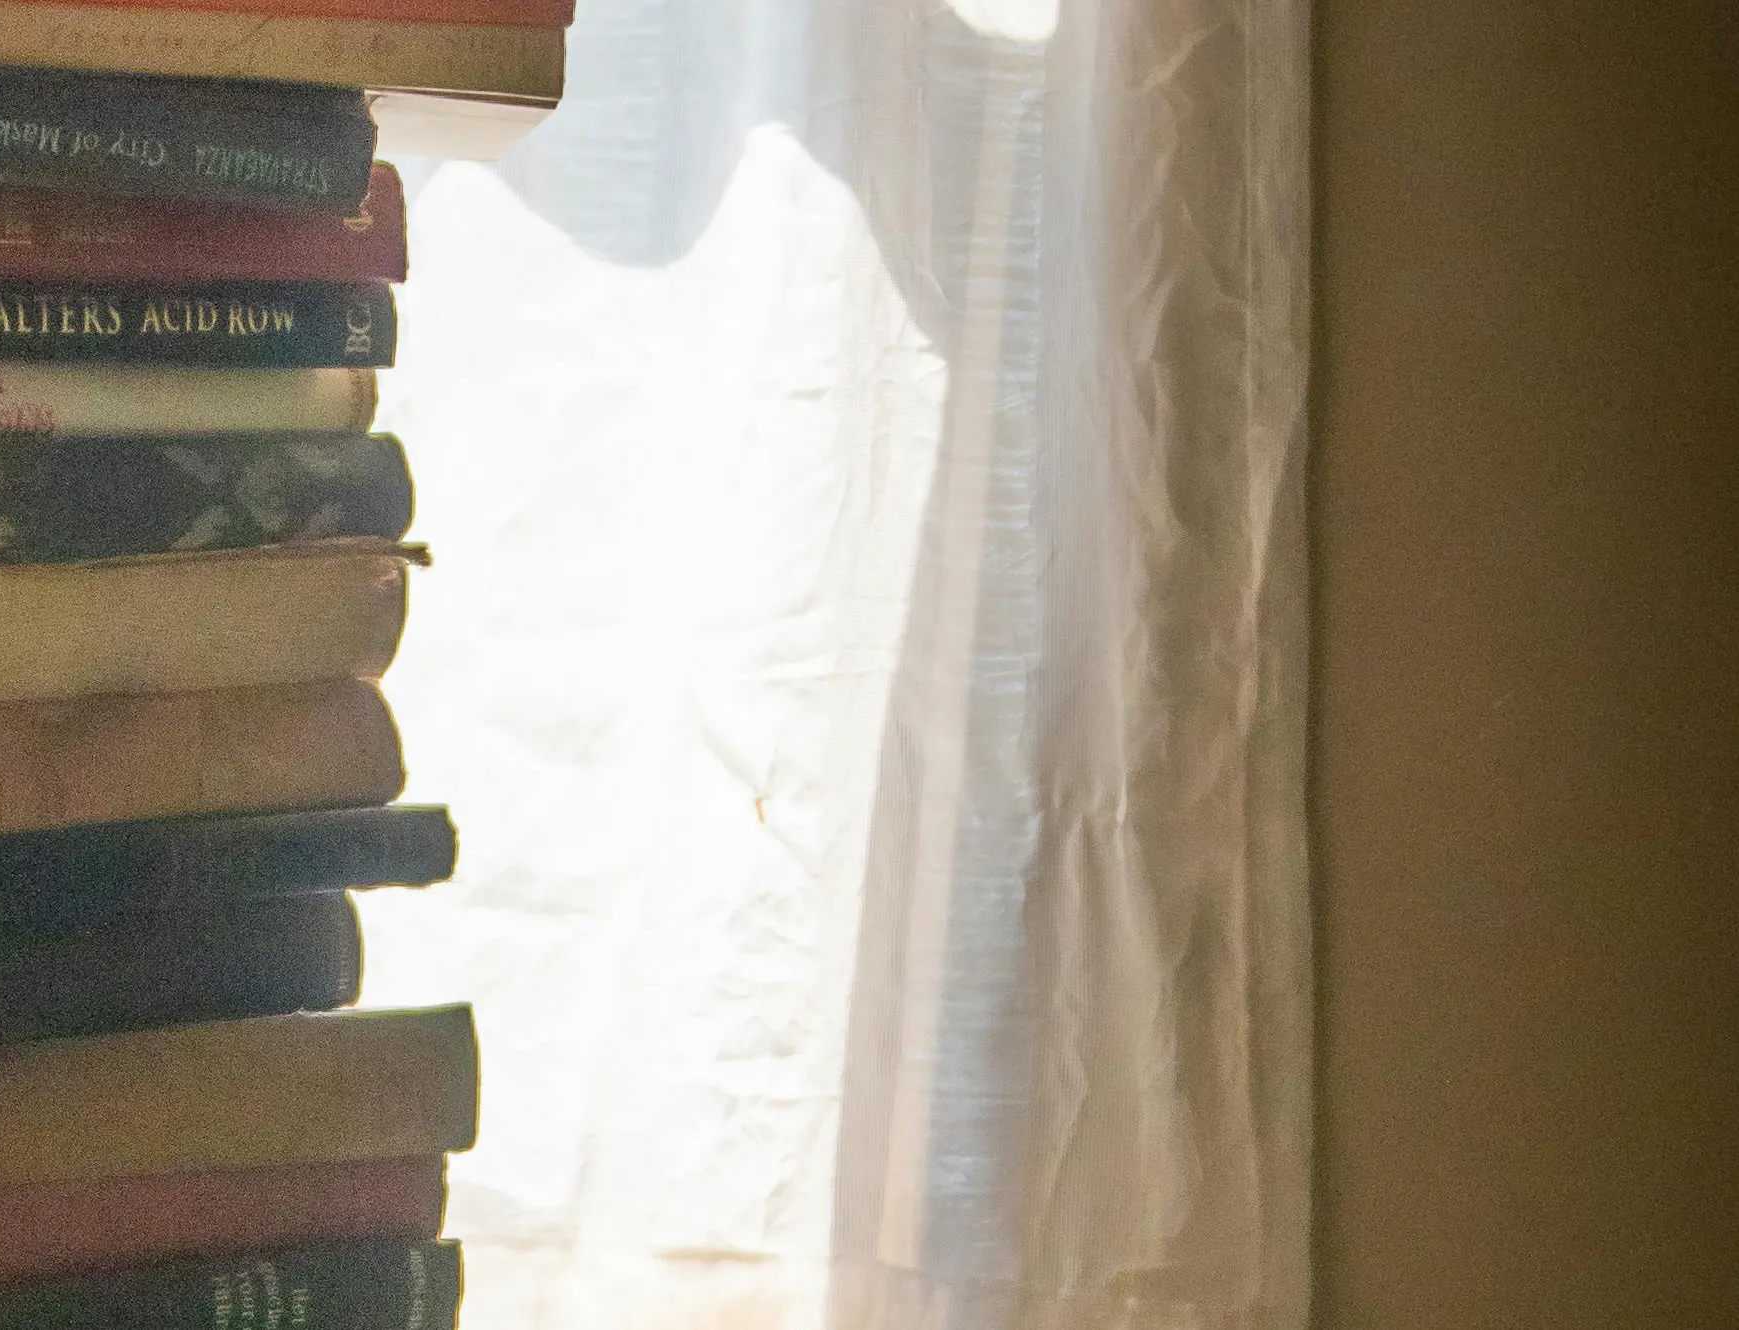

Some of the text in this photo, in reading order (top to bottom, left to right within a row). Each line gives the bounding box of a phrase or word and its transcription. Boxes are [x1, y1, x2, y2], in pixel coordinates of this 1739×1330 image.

[68, 130, 100, 156] of
[109, 129, 167, 167] City
[141, 301, 218, 335] ACID
[227, 303, 296, 335] ROW
